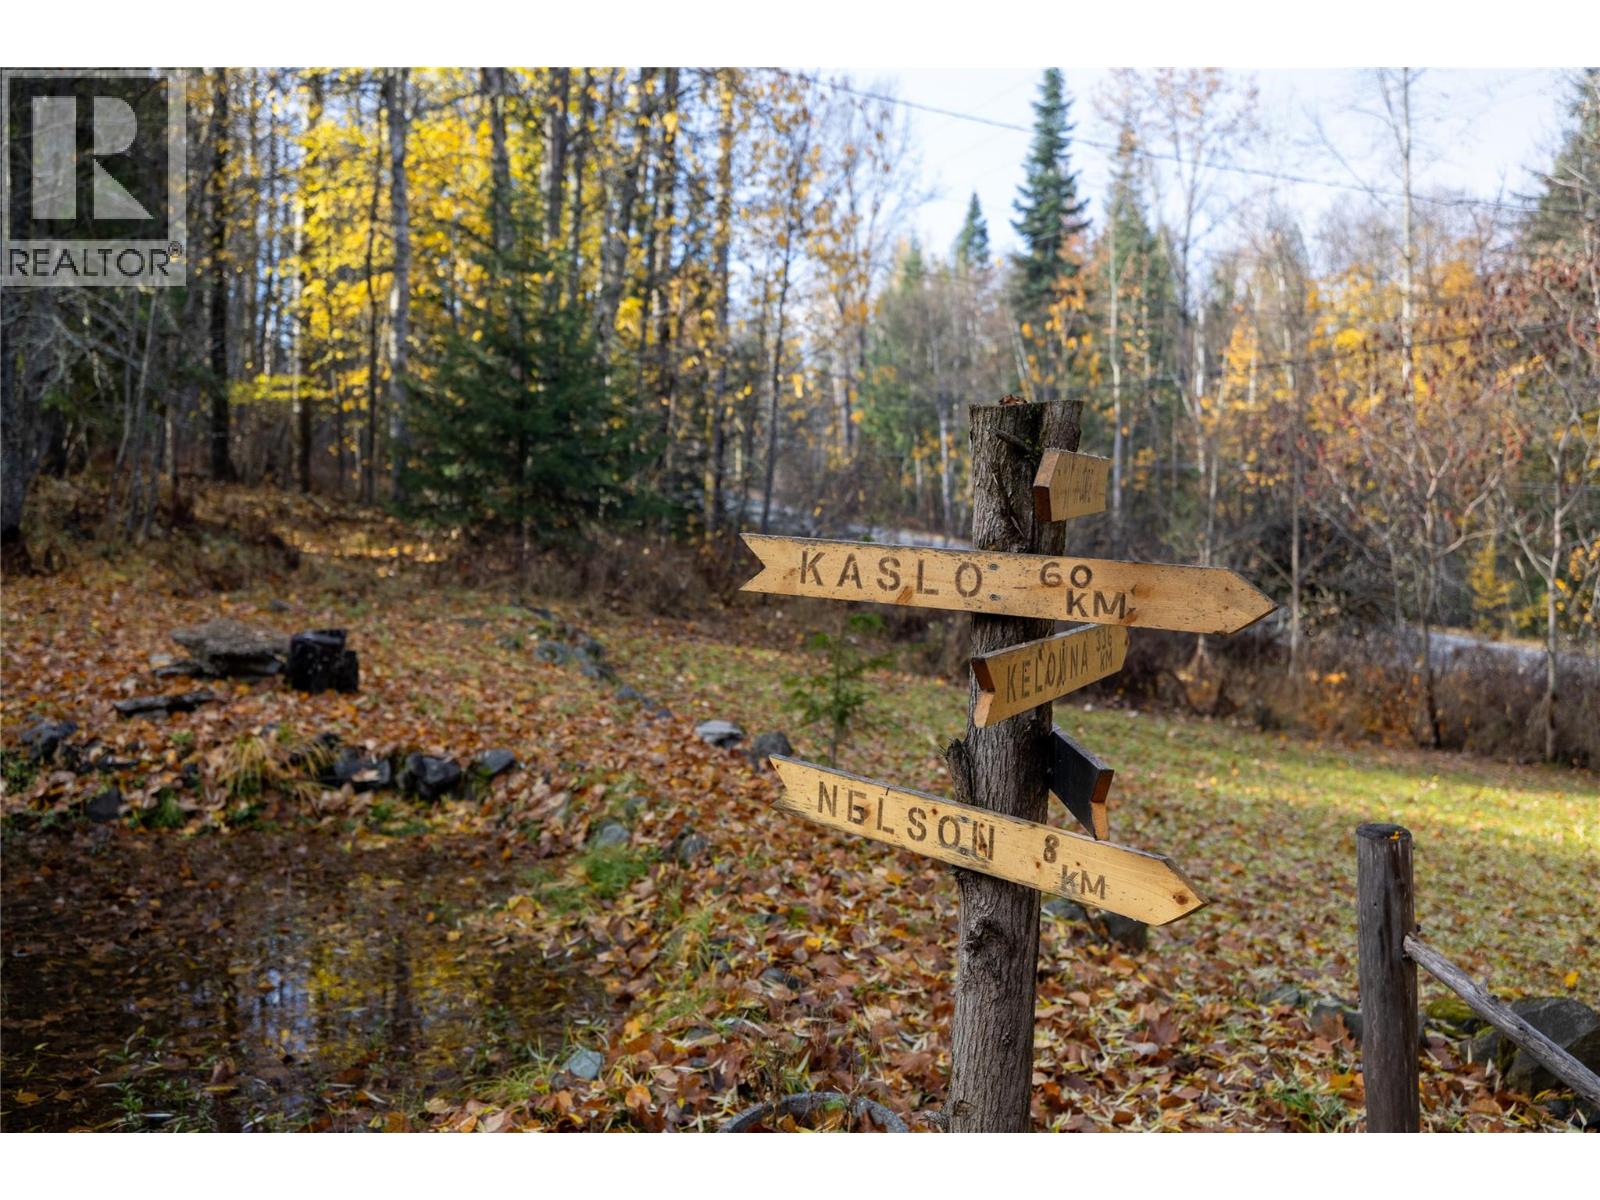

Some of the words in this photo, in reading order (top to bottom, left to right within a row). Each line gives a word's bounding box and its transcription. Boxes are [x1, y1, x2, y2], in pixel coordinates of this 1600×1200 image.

[799, 549, 983, 598] KASLO
[1039, 561, 1094, 589] 60
[1066, 588, 1127, 620] KM
[1099, 647, 1114, 673] KM
[817, 780, 996, 862] NELSON
[1043, 833, 1060, 864] 8
[1060, 864, 1106, 900] KM
